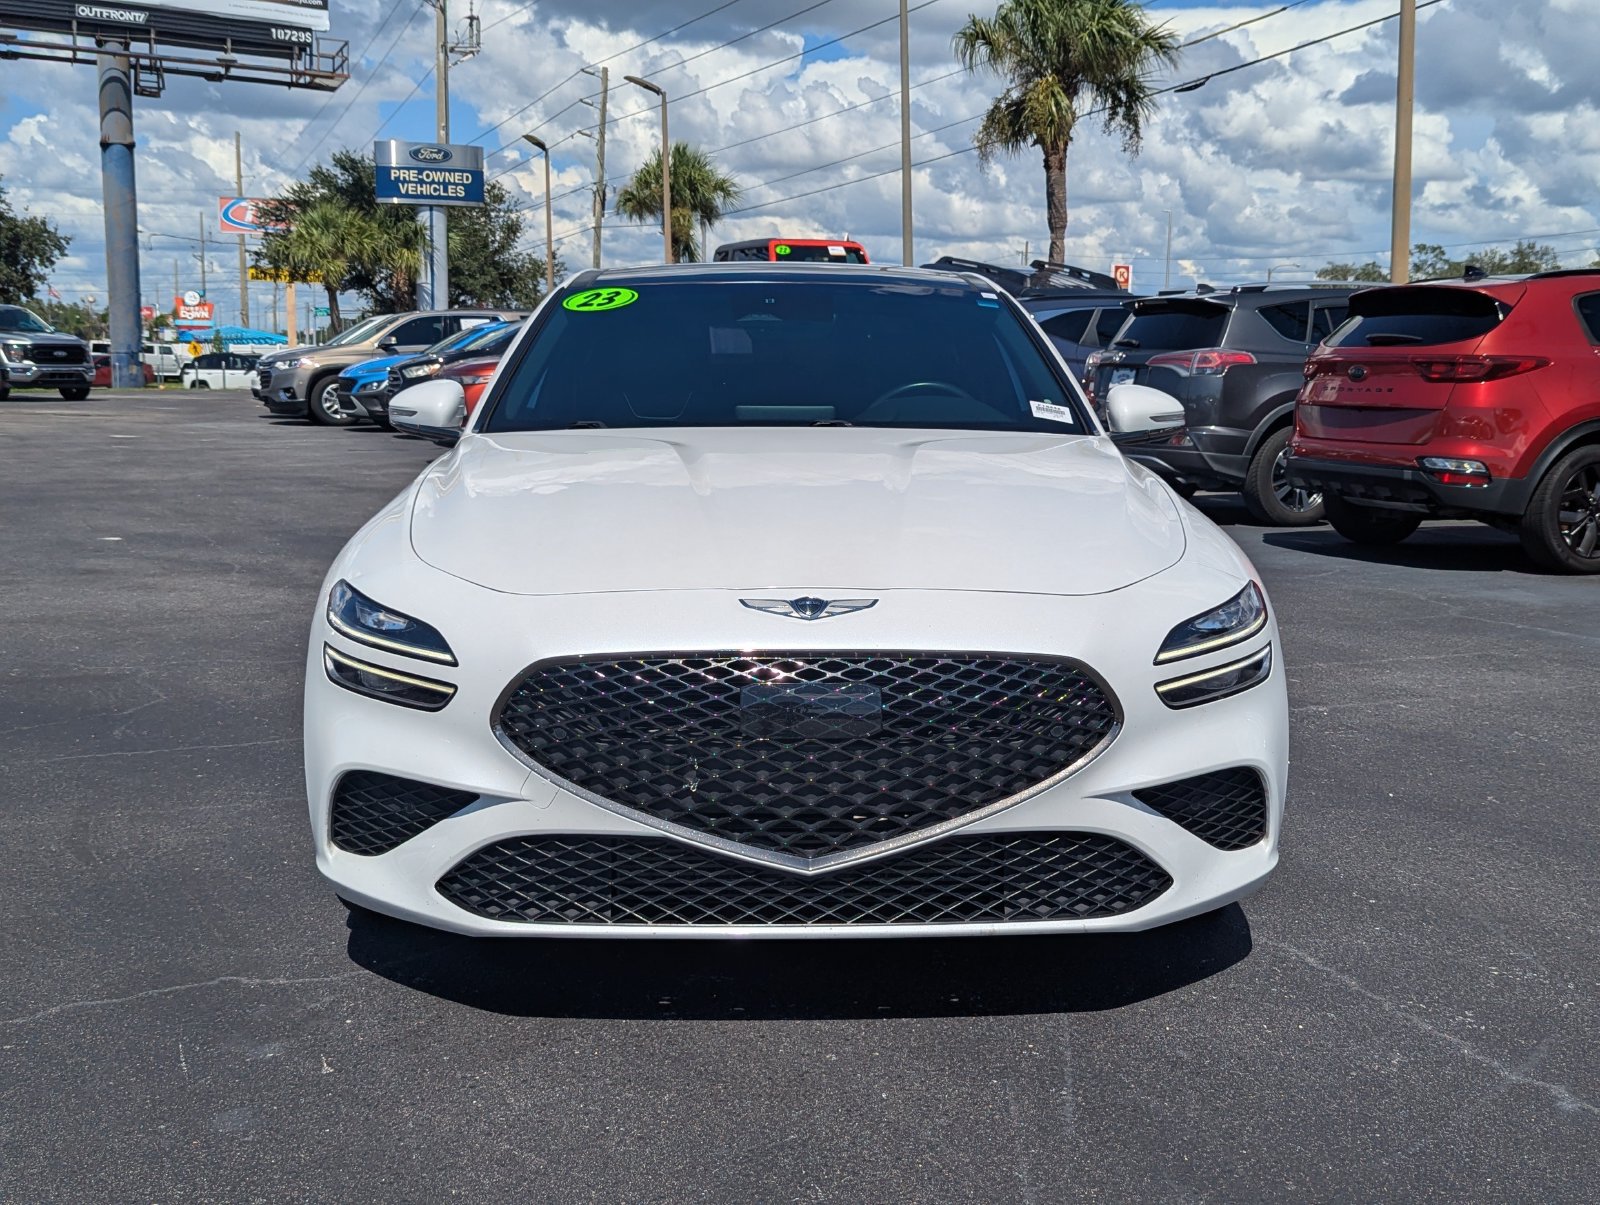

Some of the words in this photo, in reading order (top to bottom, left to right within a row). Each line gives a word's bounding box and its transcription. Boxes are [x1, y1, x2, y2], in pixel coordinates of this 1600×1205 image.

[270, 28, 312, 43] 10729S
[418, 148, 445, 160] Ford
[390, 169, 472, 184] PRE-OWNED
[398, 182, 466, 197] VEHICLES
[575, 291, 622, 308] 23
